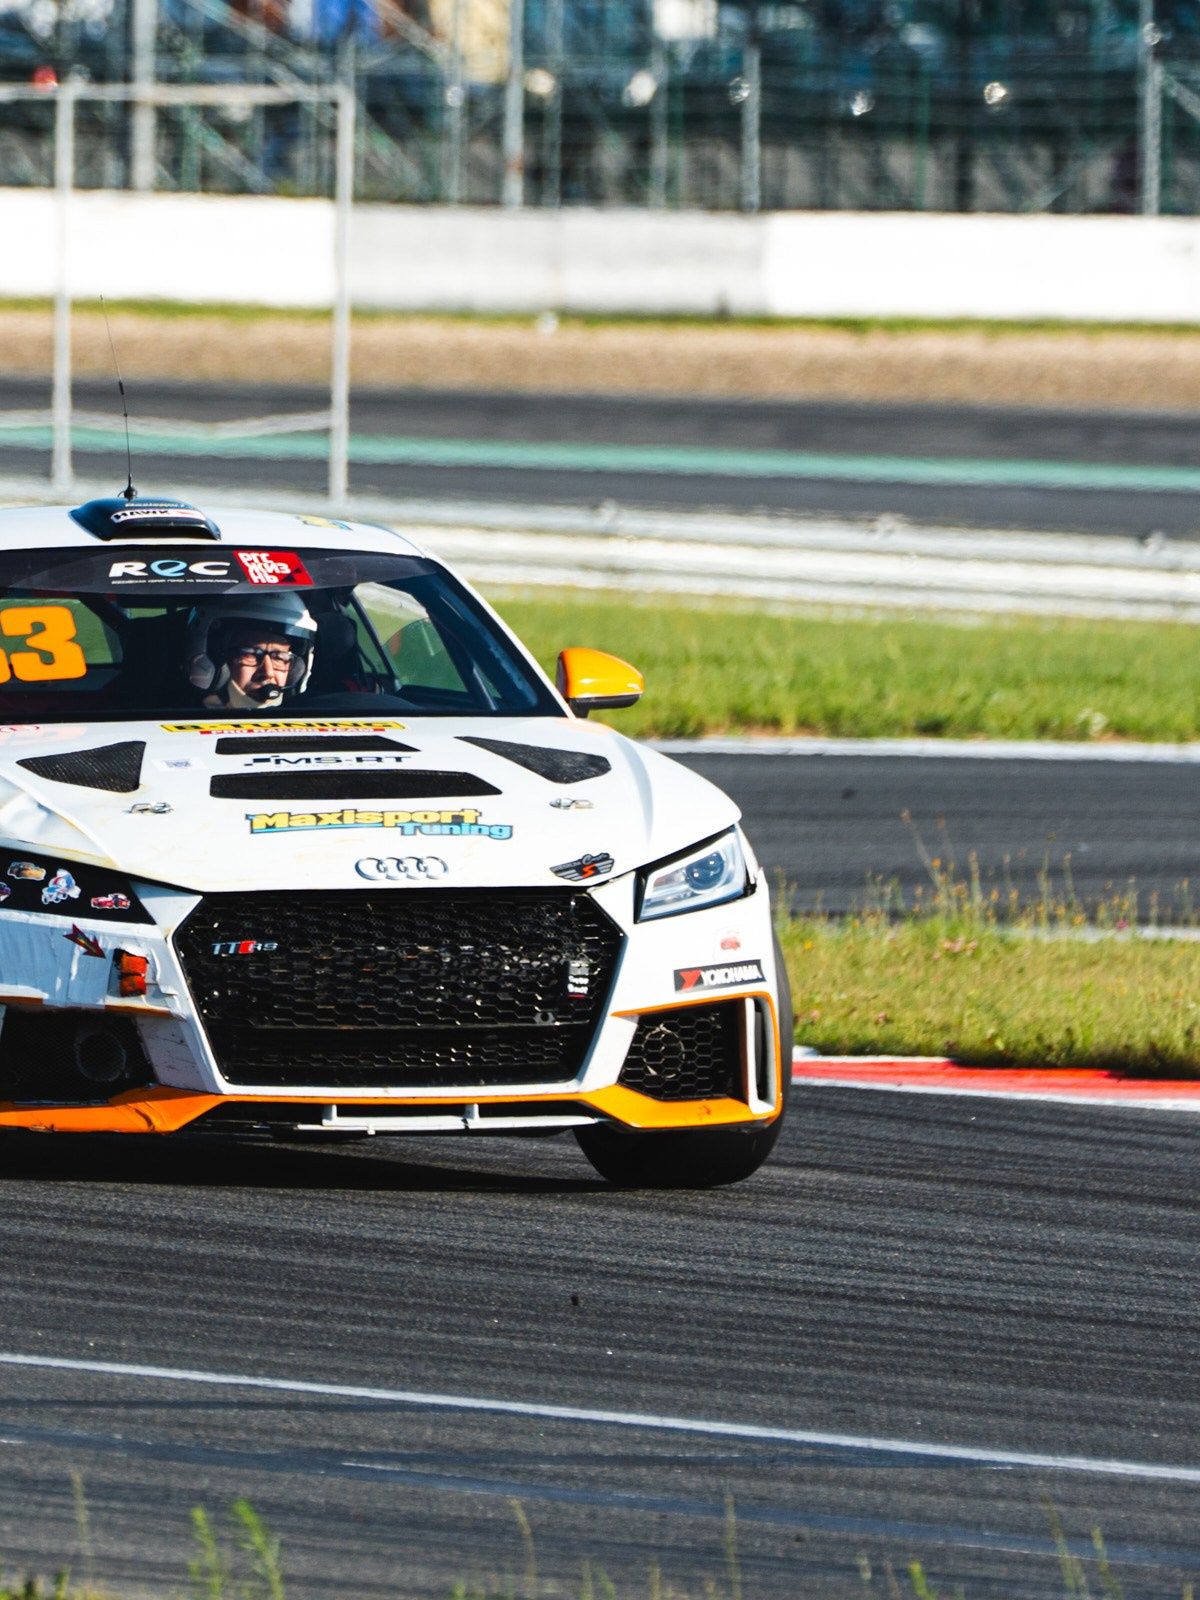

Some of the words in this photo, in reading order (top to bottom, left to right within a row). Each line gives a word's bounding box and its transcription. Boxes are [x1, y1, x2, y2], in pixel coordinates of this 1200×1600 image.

[238, 552, 274, 566] РГС
[252, 809, 482, 828] Maxisport
[400, 823, 512, 839] Tuning
[700, 964, 763, 986] YOKOHAMA
